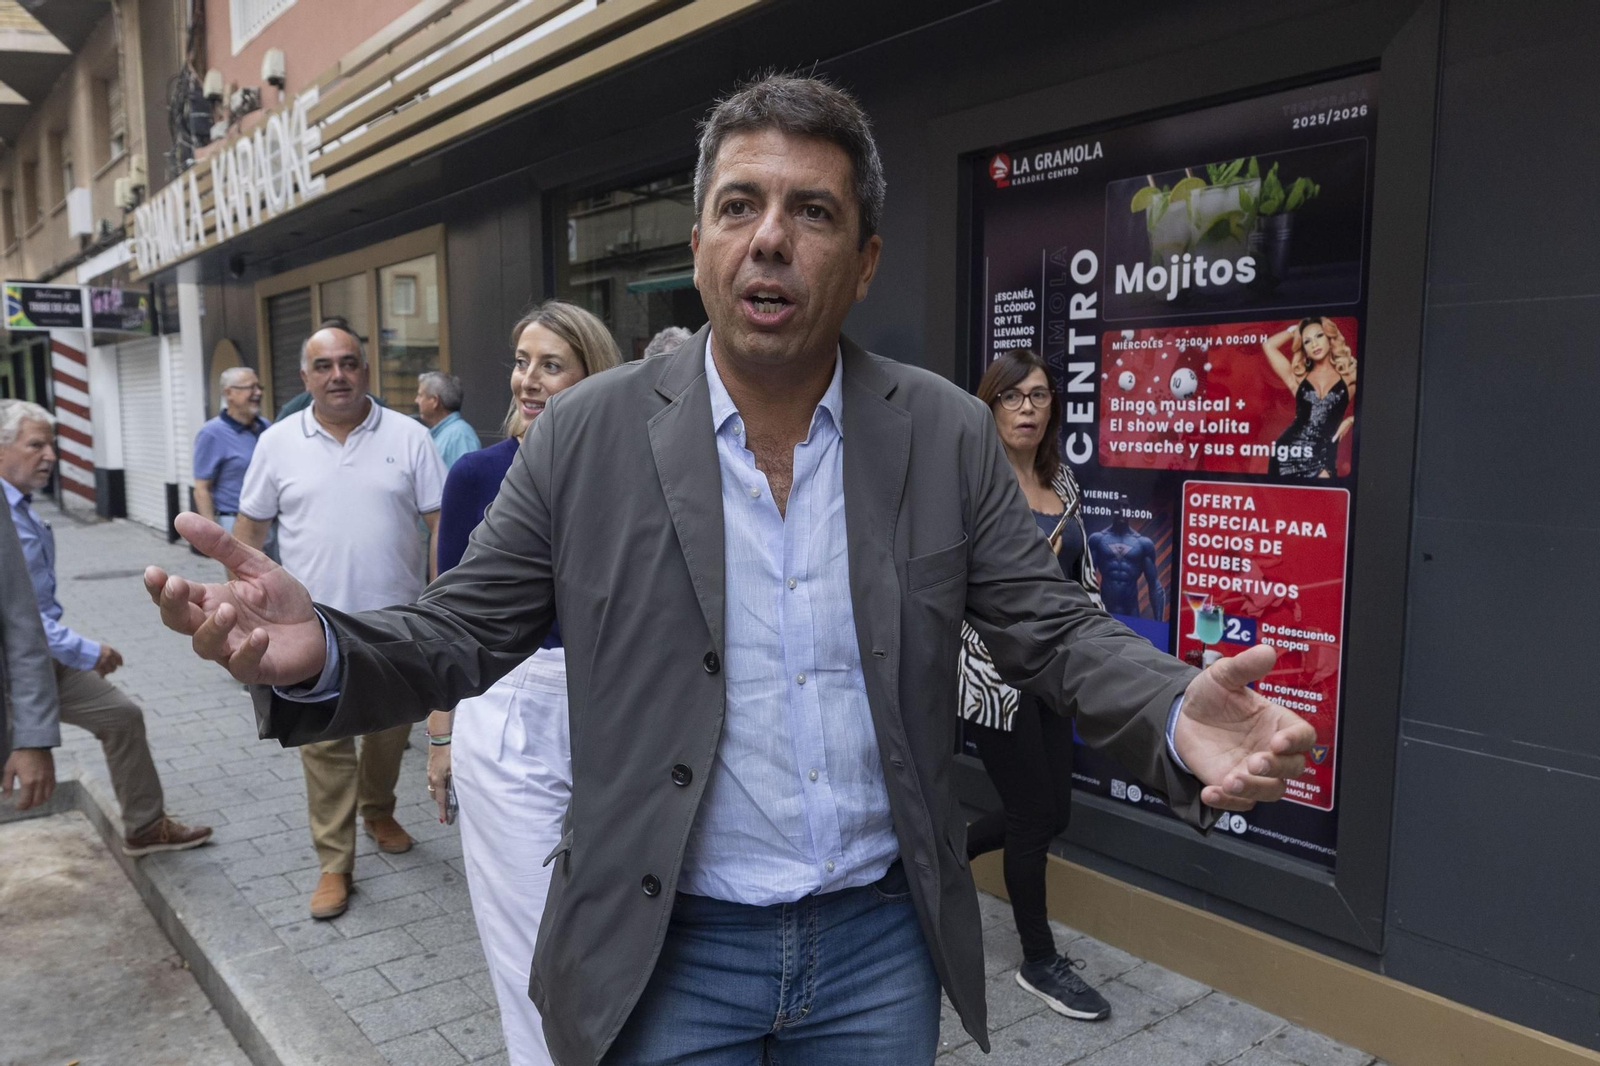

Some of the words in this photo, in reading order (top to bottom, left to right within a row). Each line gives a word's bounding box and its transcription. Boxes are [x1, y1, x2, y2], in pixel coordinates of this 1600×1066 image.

[1292, 104, 1368, 130] 2025/2026
[211, 84, 326, 243] KARAOKE
[1013, 157, 1030, 175] LA
[1035, 141, 1103, 171] GRAMOLA
[1012, 173, 1045, 186] KARAOKE
[1047, 166, 1079, 179] CENTRO
[1115, 252, 1257, 301] Mojitos
[994, 305, 1002, 314] EL
[1003, 301, 1036, 313] CÓDIGO
[994, 316, 1006, 326] QR
[1006, 316, 1012, 324] Y
[1013, 315, 1022, 324] TE
[994, 326, 1035, 337] LLEVAMOS
[993, 338, 1032, 349] DIRECTOS
[1112, 338, 1164, 350] MIÉRCOLES
[1175, 337, 1203, 347] 22:00
[1206, 337, 1212, 346] H
[1216, 336, 1223, 345] A
[1226, 335, 1257, 345] 00:00
[1260, 334, 1268, 343] H
[1066, 248, 1099, 464] CENTRO
[1110, 397, 1156, 415] Bingo
[1160, 396, 1230, 412] musical
[1110, 418, 1122, 432] El
[1127, 418, 1169, 433] show
[1174, 418, 1195, 433] de
[1200, 419, 1250, 434] Lolita
[1110, 440, 1184, 454] versache
[1189, 442, 1199, 459] y
[1204, 443, 1235, 457] sus
[1240, 441, 1314, 462] amigas
[1083, 489, 1120, 500] VIERNES
[1189, 493, 1256, 511] OFERTA
[1083, 505, 1111, 516] 16:00h
[1122, 508, 1153, 520] 18:00h
[1188, 513, 1269, 534] ESPECIAL
[1275, 519, 1328, 539] PARA
[1188, 532, 1254, 553] SOCIOS
[1259, 538, 1283, 556] DE
[1187, 552, 1252, 573] CLUBES
[1186, 571, 1300, 600] DEPORTIVOS
[1262, 623, 1276, 634] De
[1277, 625, 1336, 643] descuento
[1261, 636, 1275, 646] en
[1276, 638, 1310, 652] copas
[1259, 682, 1272, 692] en
[1274, 685, 1323, 701] cervezas
[1285, 788, 1313, 800] AMOLA!
[1286, 778, 1306, 789] TIENE
[1306, 783, 1321, 794] SUS
